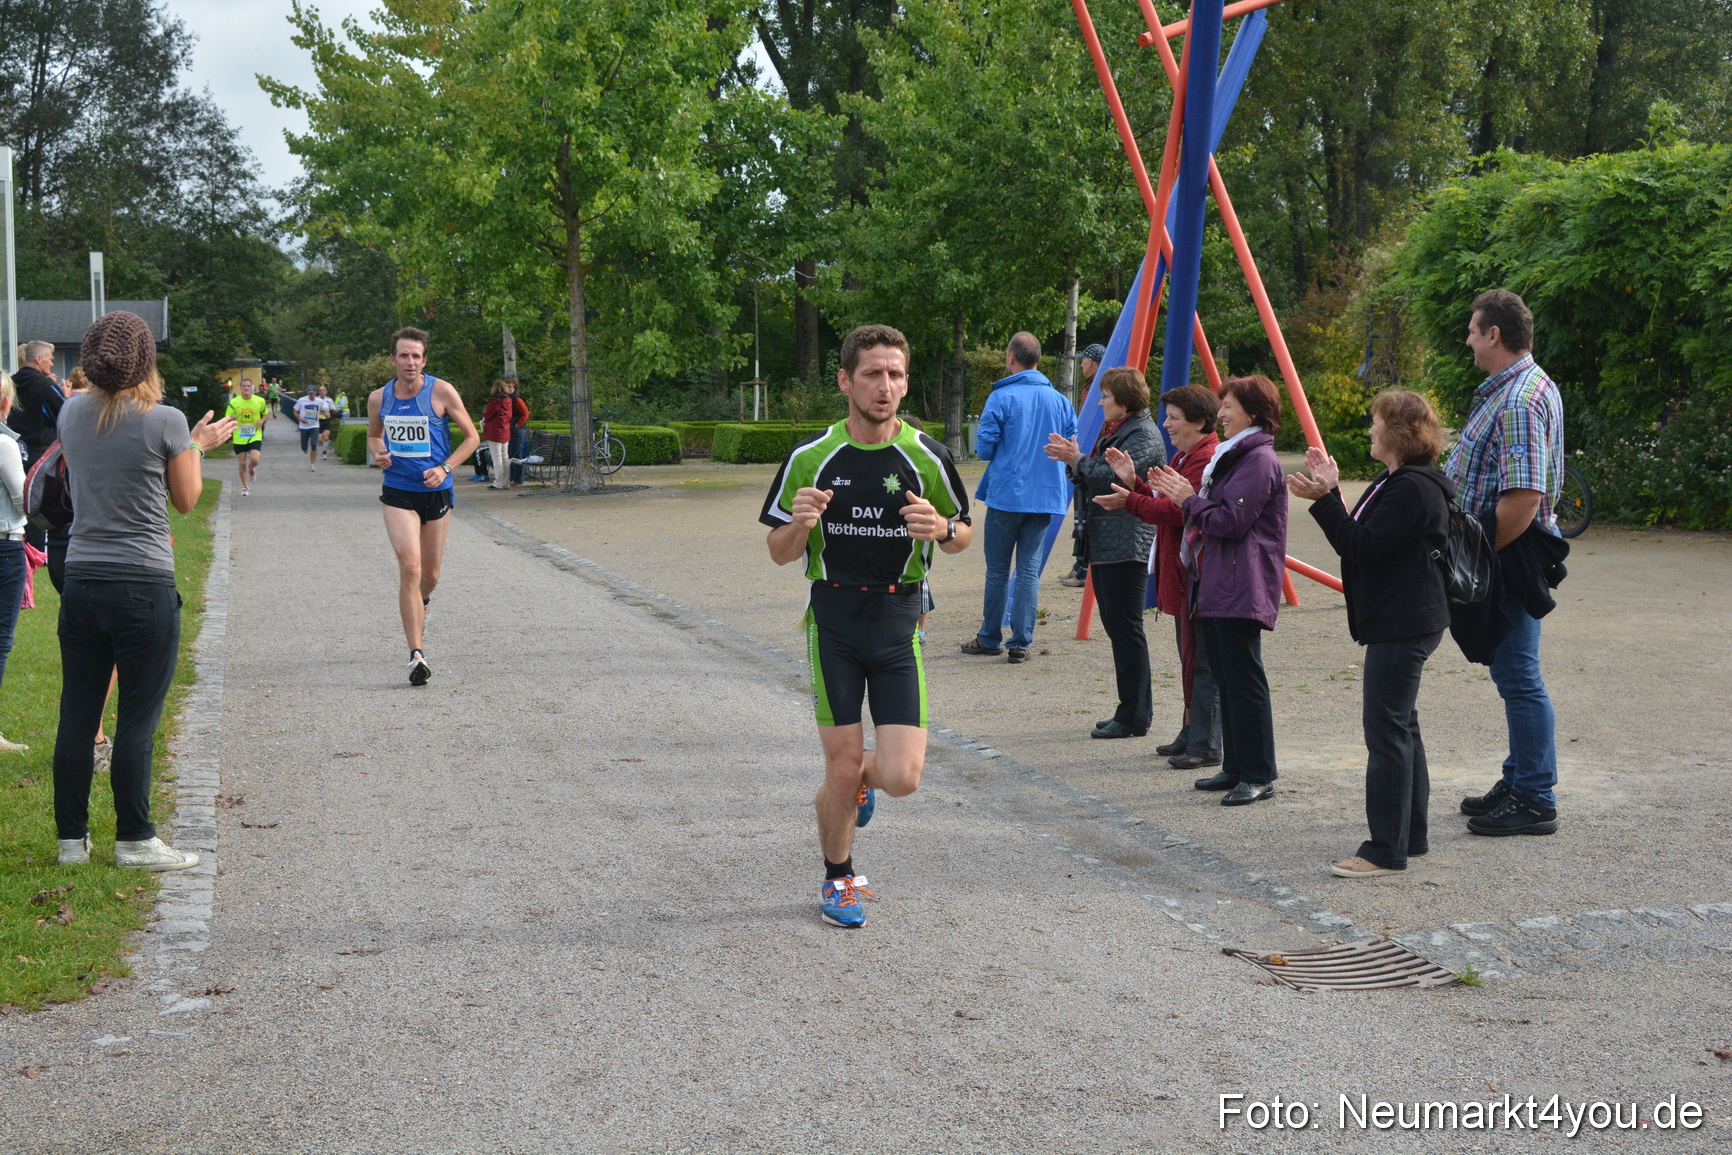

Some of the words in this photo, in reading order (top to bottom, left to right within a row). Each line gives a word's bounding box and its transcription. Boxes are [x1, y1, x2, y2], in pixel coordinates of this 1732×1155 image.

[389, 426, 425, 441] 2200
[400, 444, 414, 452] Götz
[852, 506, 884, 519] DAV
[827, 522, 908, 537] Röthenbach
